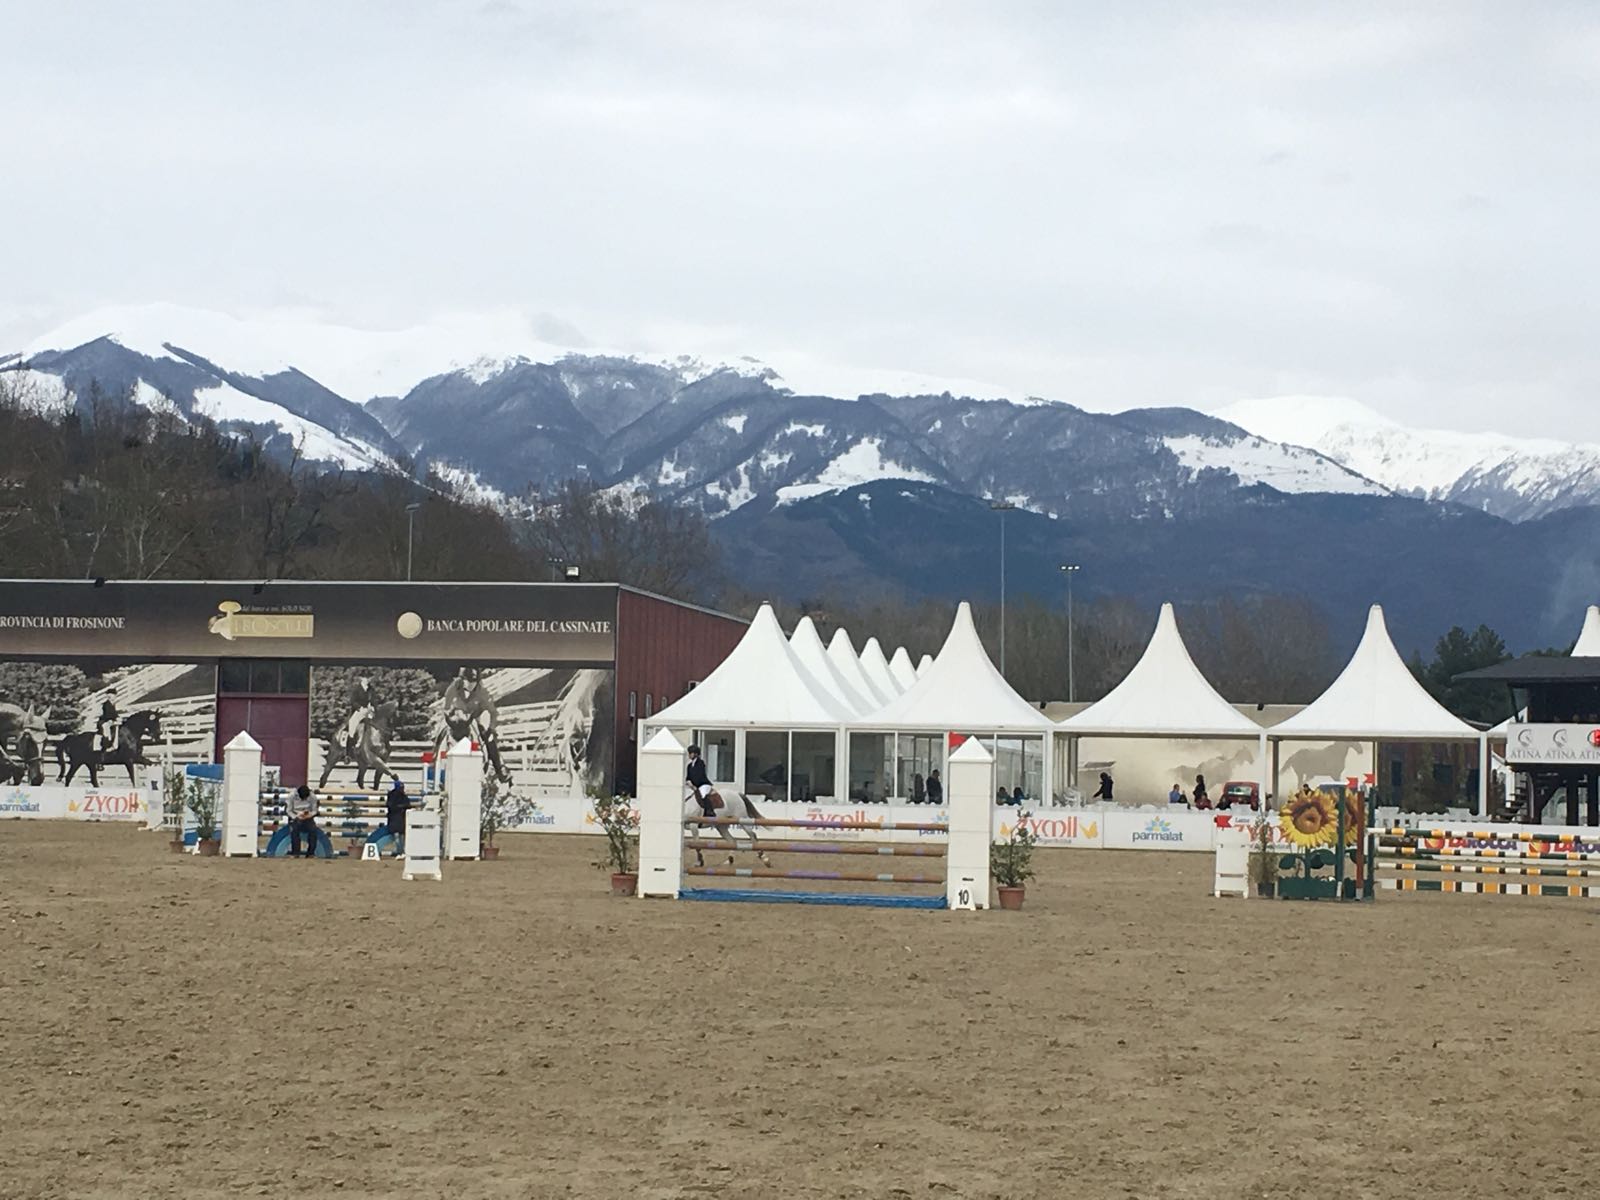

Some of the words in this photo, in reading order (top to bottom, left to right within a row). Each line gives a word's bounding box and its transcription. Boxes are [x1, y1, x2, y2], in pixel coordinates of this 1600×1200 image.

[53, 617, 64, 628] DI
[66, 617, 125, 629] FROSINONE
[427, 619, 464, 632] BANCA
[466, 620, 525, 632] POPOLARE
[527, 621, 548, 633] DEL
[550, 621, 610, 633] CASSINATE
[1510, 750, 1541, 759] ATINA
[1545, 750, 1577, 760] ATINA
[0, 803, 40, 812] armalat
[508, 815, 555, 826] pmalat
[1132, 831, 1183, 842] parmalat
[367, 845, 376, 858] B
[958, 889, 970, 905] 10
